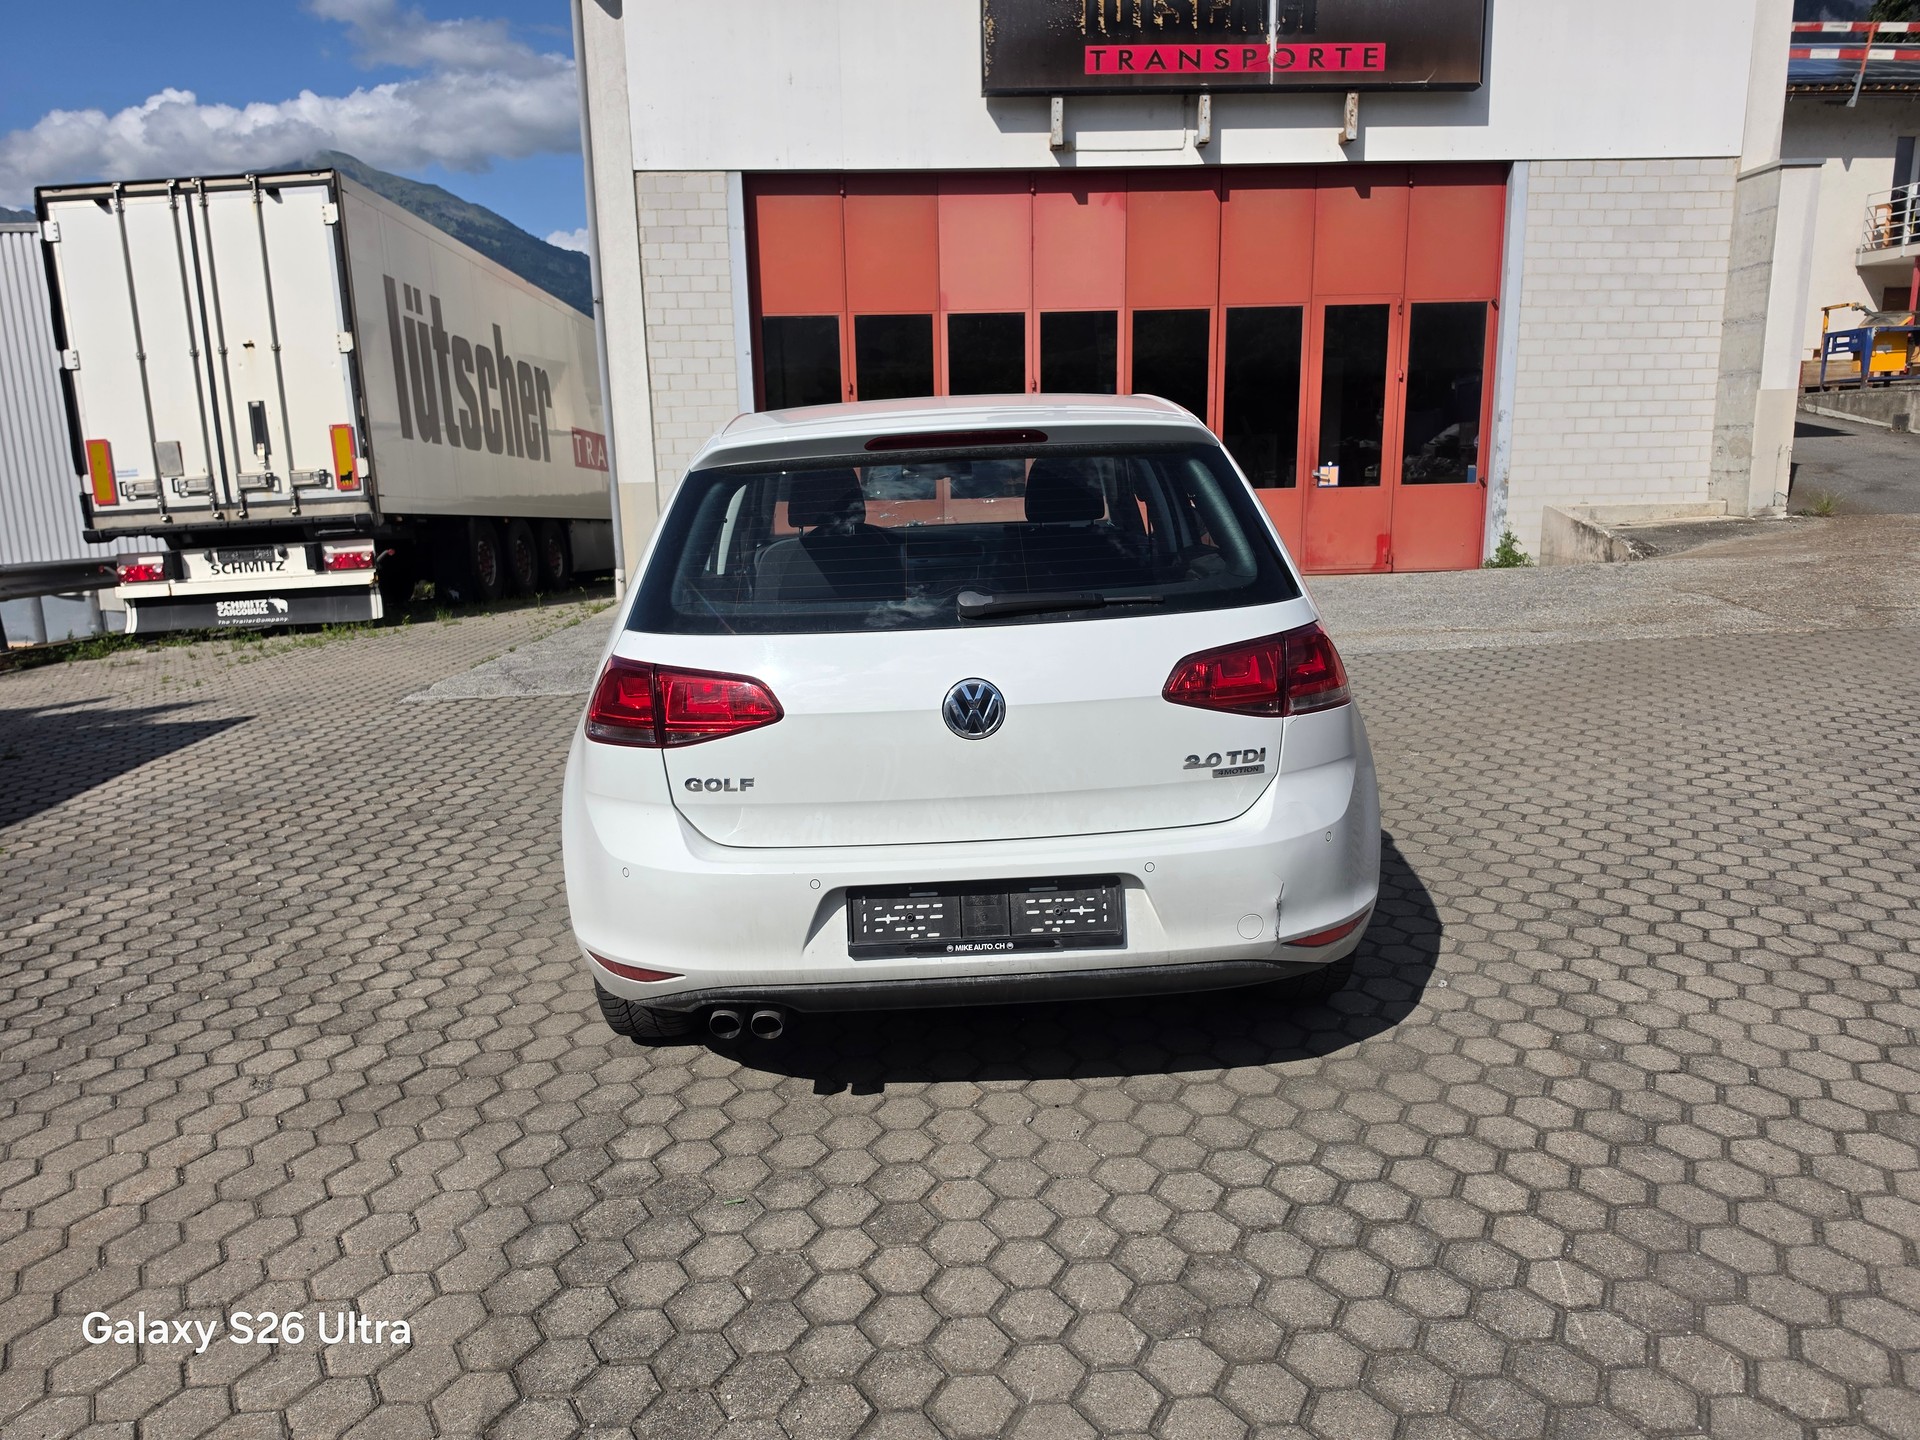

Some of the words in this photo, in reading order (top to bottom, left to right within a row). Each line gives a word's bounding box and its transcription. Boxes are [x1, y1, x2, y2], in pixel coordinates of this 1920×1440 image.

[1089, 47, 1380, 71] TRANSPORTE
[383, 274, 552, 463] lütscher
[210, 560, 286, 576] SCHMITZ
[216, 599, 269, 611] SCHMITZ
[1226, 747, 1266, 765] TDI
[1217, 765, 1260, 776] 4MOTION
[684, 777, 755, 792] GOLF
[954, 944, 973, 952] MIKE
[973, 942, 1005, 951] AUTO.CH
